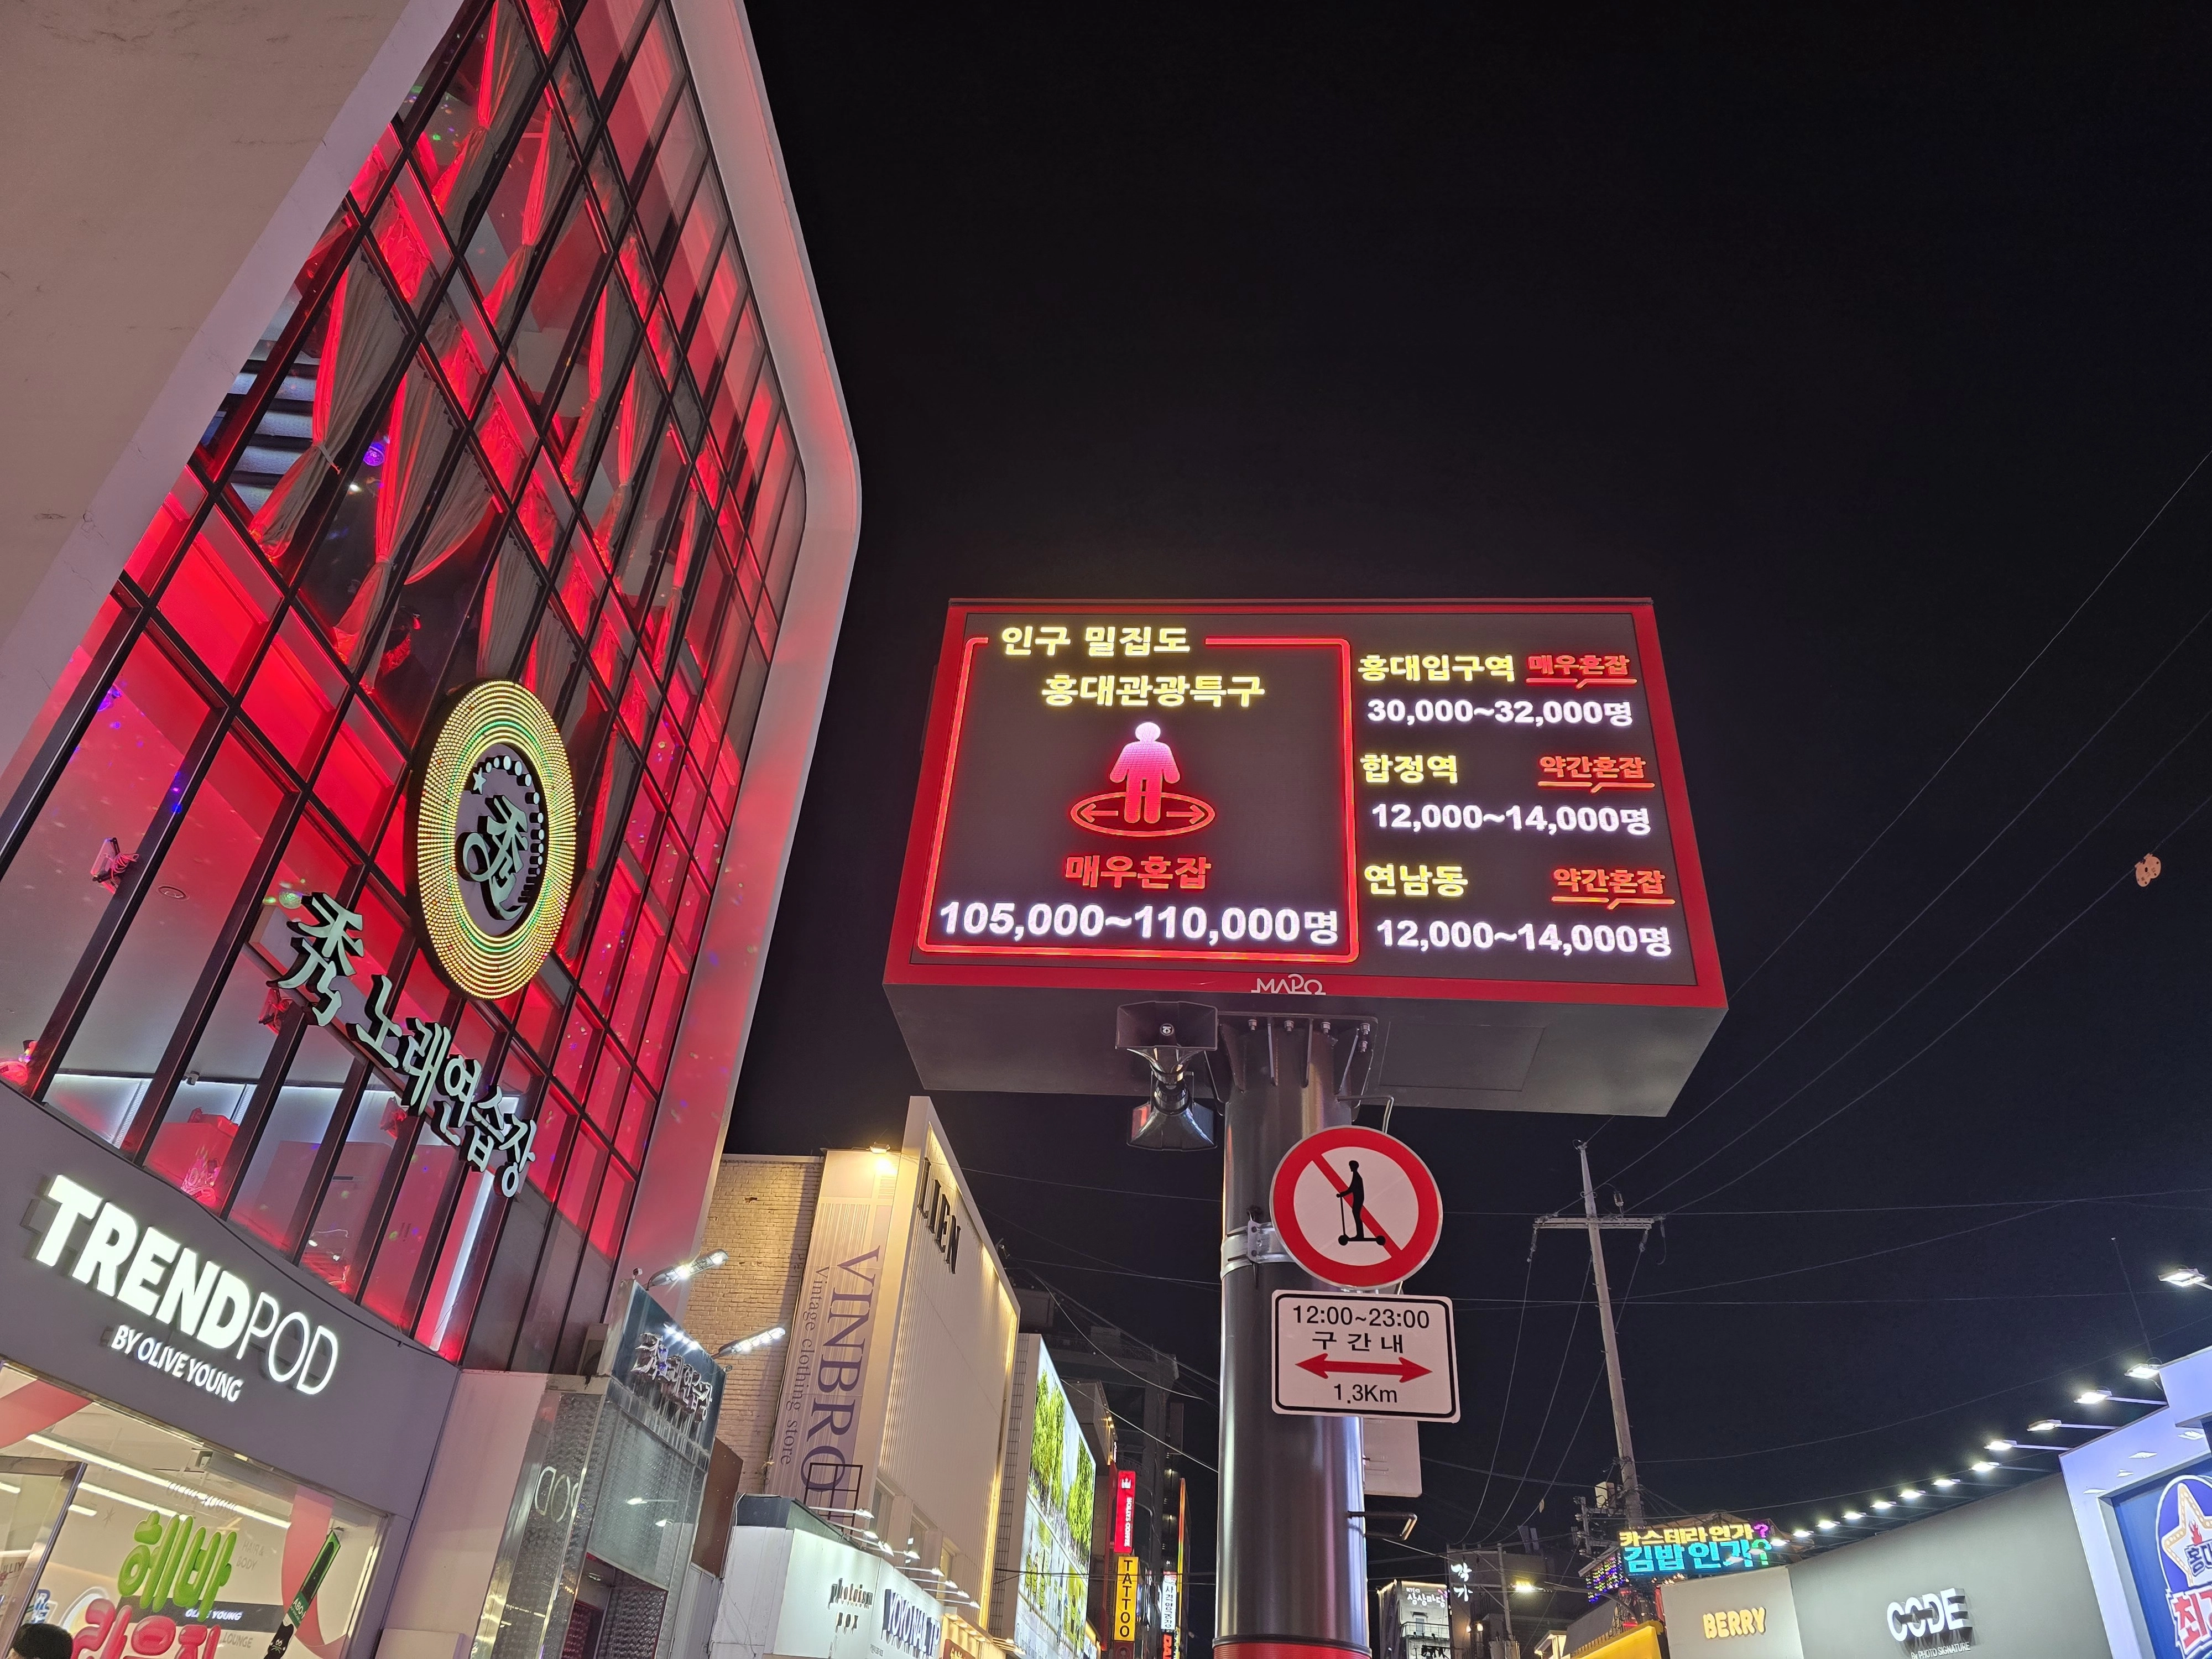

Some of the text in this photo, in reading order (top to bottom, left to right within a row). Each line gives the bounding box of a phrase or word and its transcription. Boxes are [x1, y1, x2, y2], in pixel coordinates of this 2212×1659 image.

[1001, 625, 1190, 658] 인구 밀집도
[1358, 654, 1630, 682] 홍대입구역 매우혼잡
[1041, 674, 1265, 707] 홍대관광특구
[1367, 699, 1633, 727] 30,000~32,000명
[1360, 754, 1647, 784] 합정역 약간혼잡
[1371, 803, 1652, 836] 12,000~14,000명
[1066, 855, 1211, 889] 매우혼잡
[1364, 863, 1666, 898] 연남동 약간혼잡
[940, 901, 1339, 945] 105,000~110,000명
[1376, 919, 1672, 958] 12,000~14,000명
[1251, 973, 1326, 995] MAPO
[354, 974, 536, 1199] 노래연습장
[917, 1157, 962, 1275] LIEN
[1293, 1304, 1430, 1329] 12:00~23:00
[111, 1324, 245, 1404] BY OLIVE YOUNG
[780, 1265, 830, 1466] Vintage clothing store
[800, 1245, 881, 1495] VINBRO
[1333, 1384, 1398, 1405] 1.3Km
[117, 1510, 238, 1622] 헤바
[236, 1556, 258, 1571] BODY
[1119, 1559, 1133, 1637] TATTOO
[1407, 1592, 1446, 1608] 상상마당
[212, 1610, 243, 1621] YOUNG
[1703, 1607, 1766, 1639] BERRY
[1887, 1588, 1968, 1642] CODE
[222, 1632, 253, 1648] LOUNGE
[1919, 1647, 1938, 1659] PHOTO
[1938, 1641, 1971, 1656] SIGNATURE
